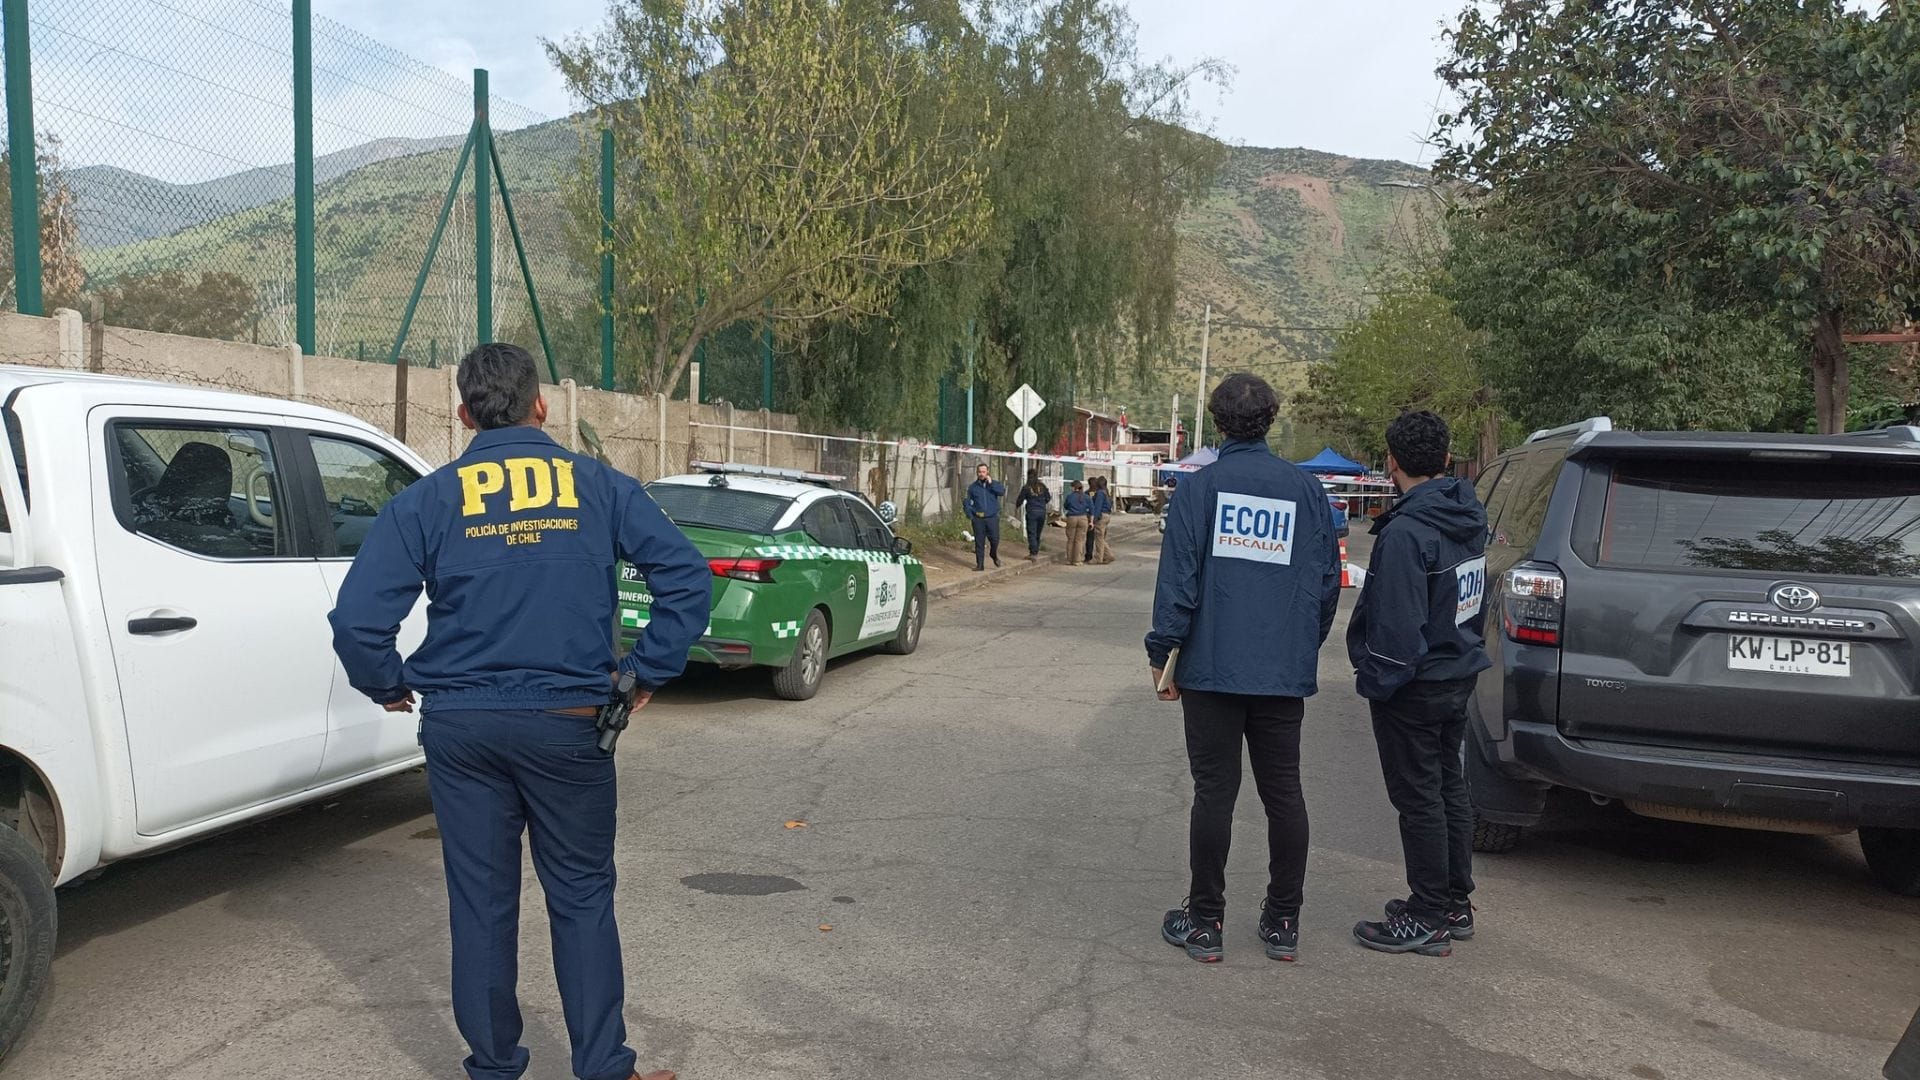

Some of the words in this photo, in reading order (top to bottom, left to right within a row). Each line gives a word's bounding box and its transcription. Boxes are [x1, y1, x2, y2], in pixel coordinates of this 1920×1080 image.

[457, 457, 579, 517] PDI
[465, 523, 497, 538] POLICÍA
[498, 523, 509, 535] DE
[510, 519, 578, 532] INVESTIGACIONES
[1220, 504, 1290, 541] ECOH
[506, 534, 517, 545] DE
[518, 532, 541, 544] CHILE
[1219, 536, 1285, 552] FISCALIA
[1458, 567, 1483, 602] COH
[1769, 664, 1809, 673] CHILE
